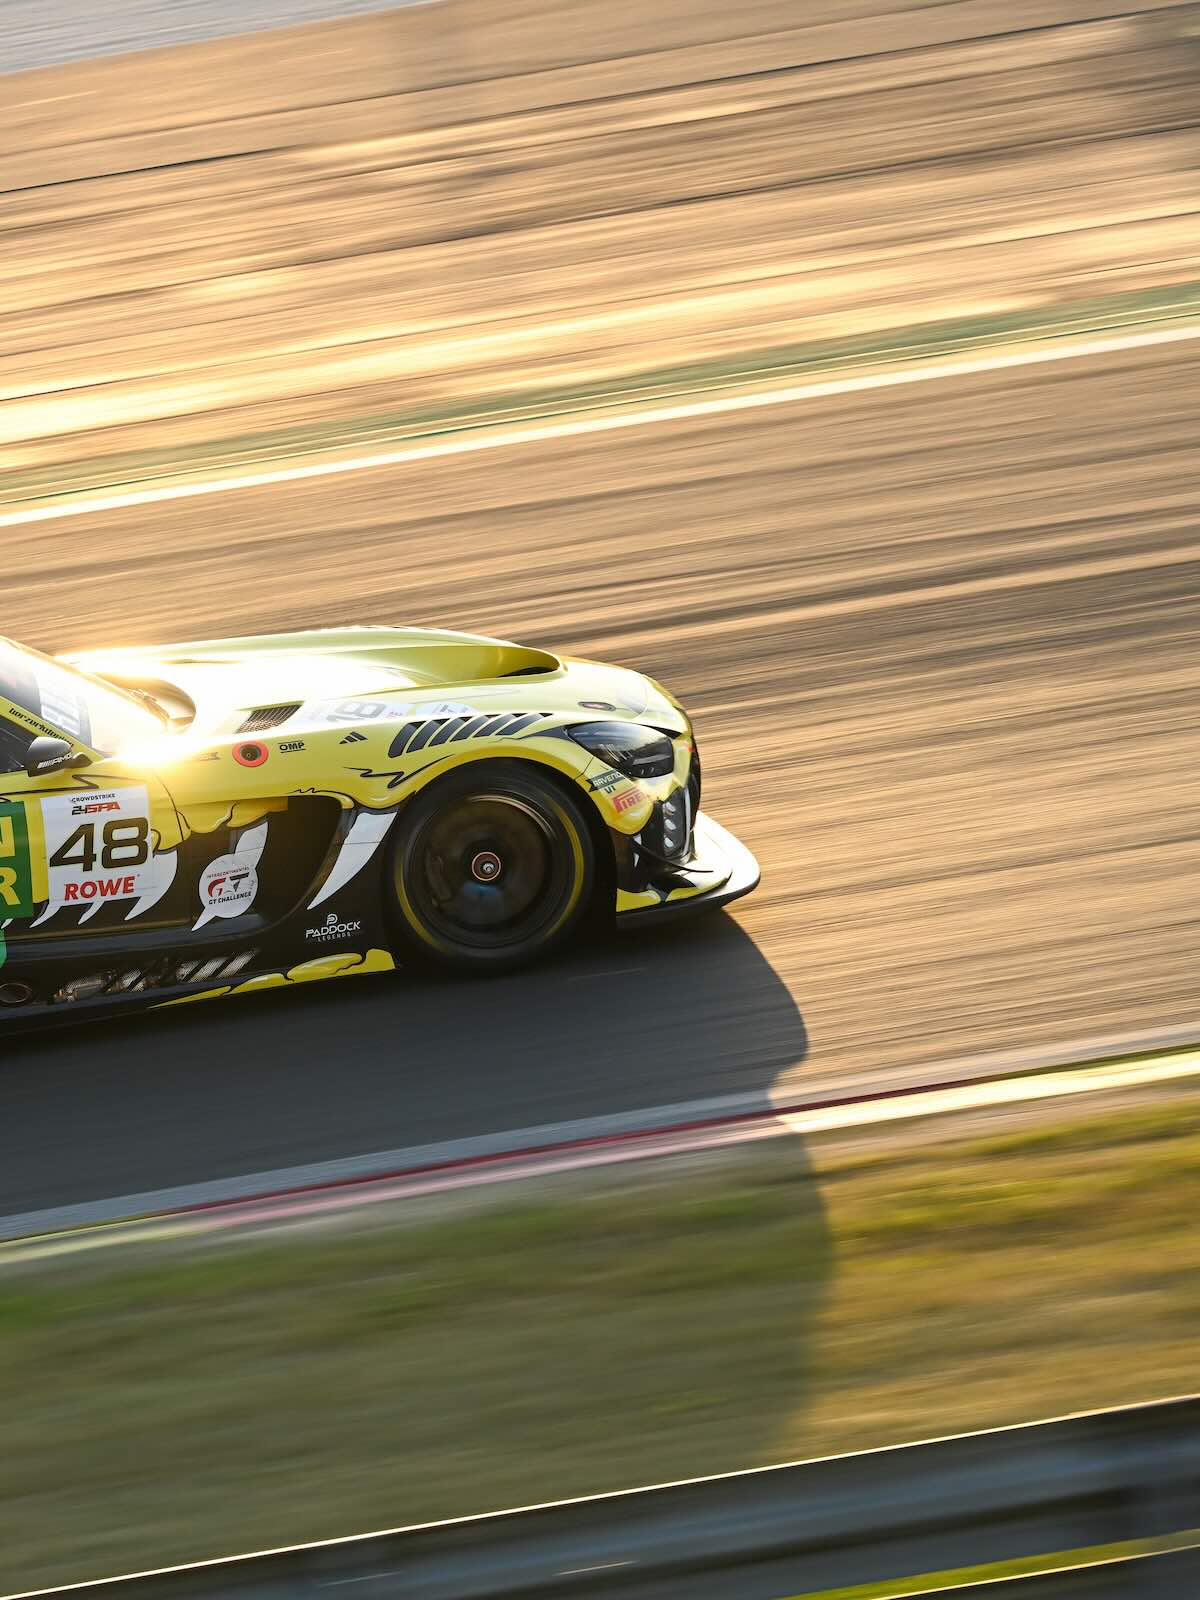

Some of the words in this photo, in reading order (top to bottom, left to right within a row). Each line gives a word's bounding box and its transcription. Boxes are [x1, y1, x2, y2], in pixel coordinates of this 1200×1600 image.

[279, 741, 305, 751] OMP
[71, 793, 116, 804] CROWDSTRIKE
[49, 817, 149, 873] 48
[64, 876, 136, 902] ROWE
[218, 891, 252, 904] CHALLENGE
[305, 920, 361, 938] PADDOCK
[318, 932, 351, 942] LEGENDS
